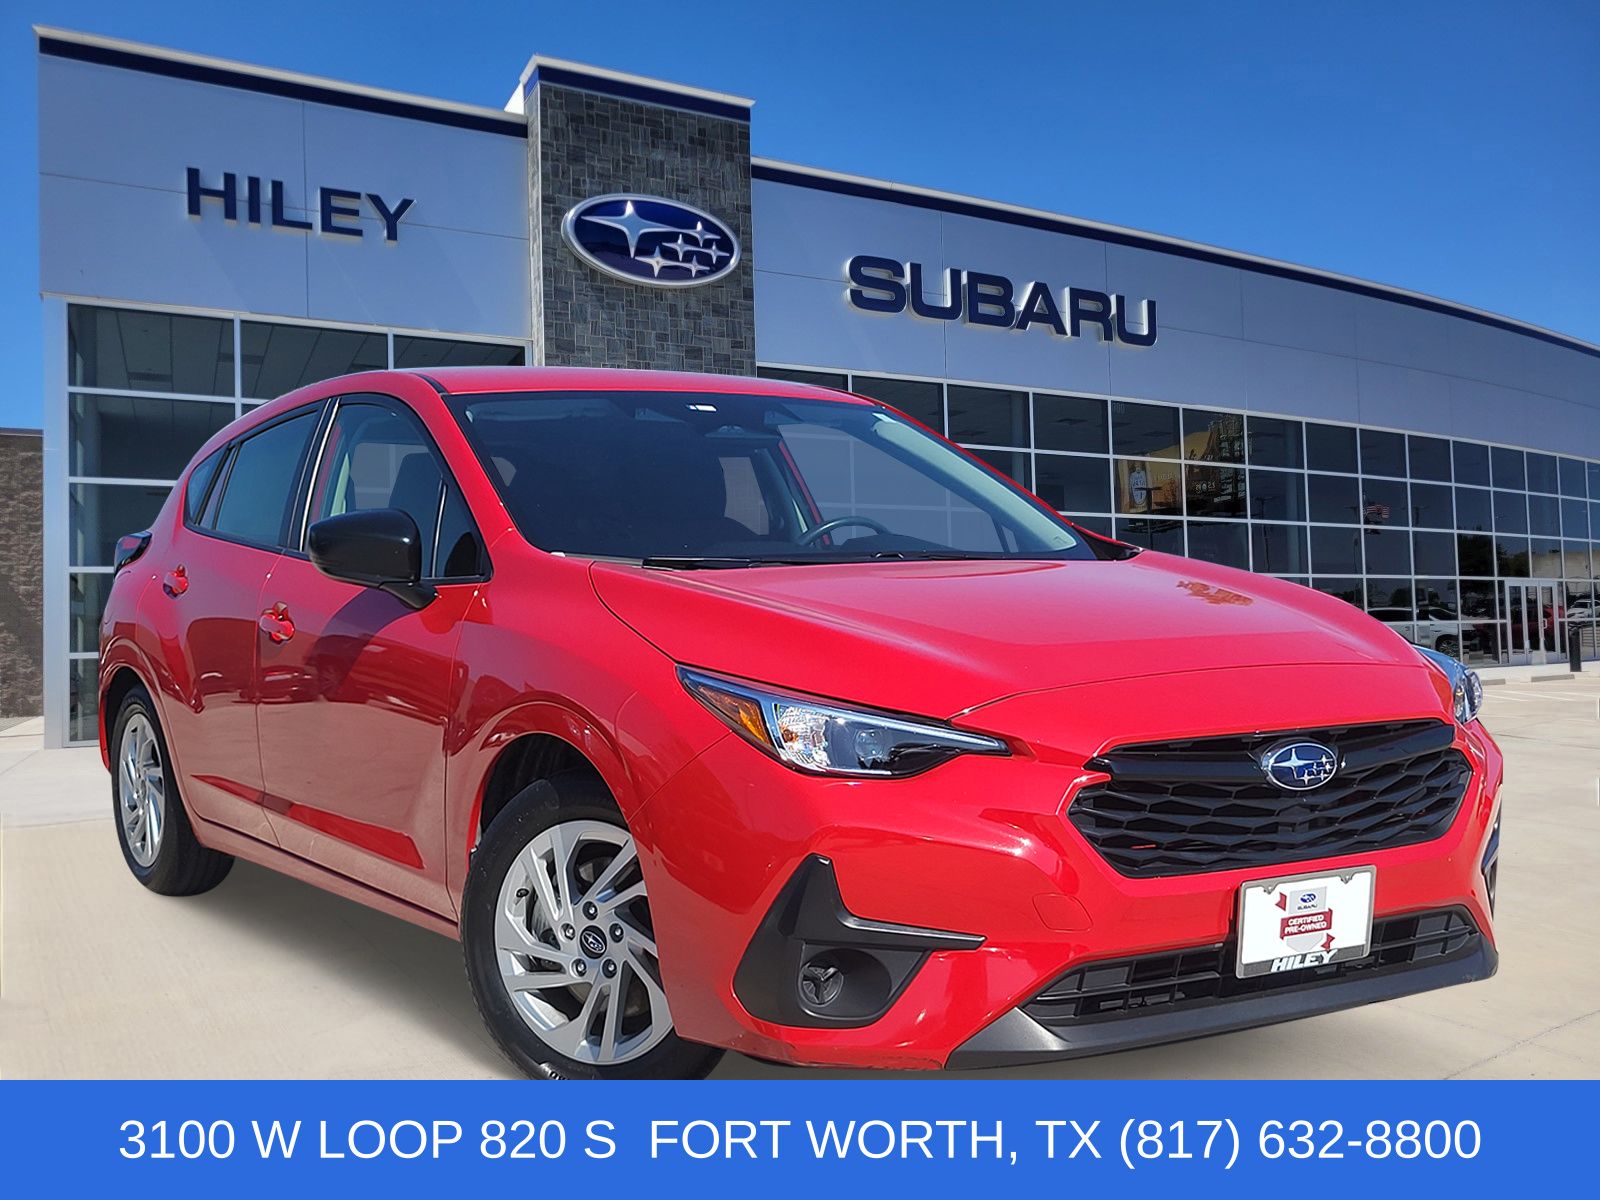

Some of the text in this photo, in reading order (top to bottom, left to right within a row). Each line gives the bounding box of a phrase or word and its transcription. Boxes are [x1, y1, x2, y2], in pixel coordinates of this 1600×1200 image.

[186, 167, 416, 241] HILEY
[846, 254, 1157, 347] SUBARU
[1284, 921, 1327, 934] PRE-OWNED
[1288, 915, 1324, 925] CERTIFIED
[1271, 949, 1338, 972] HILEY
